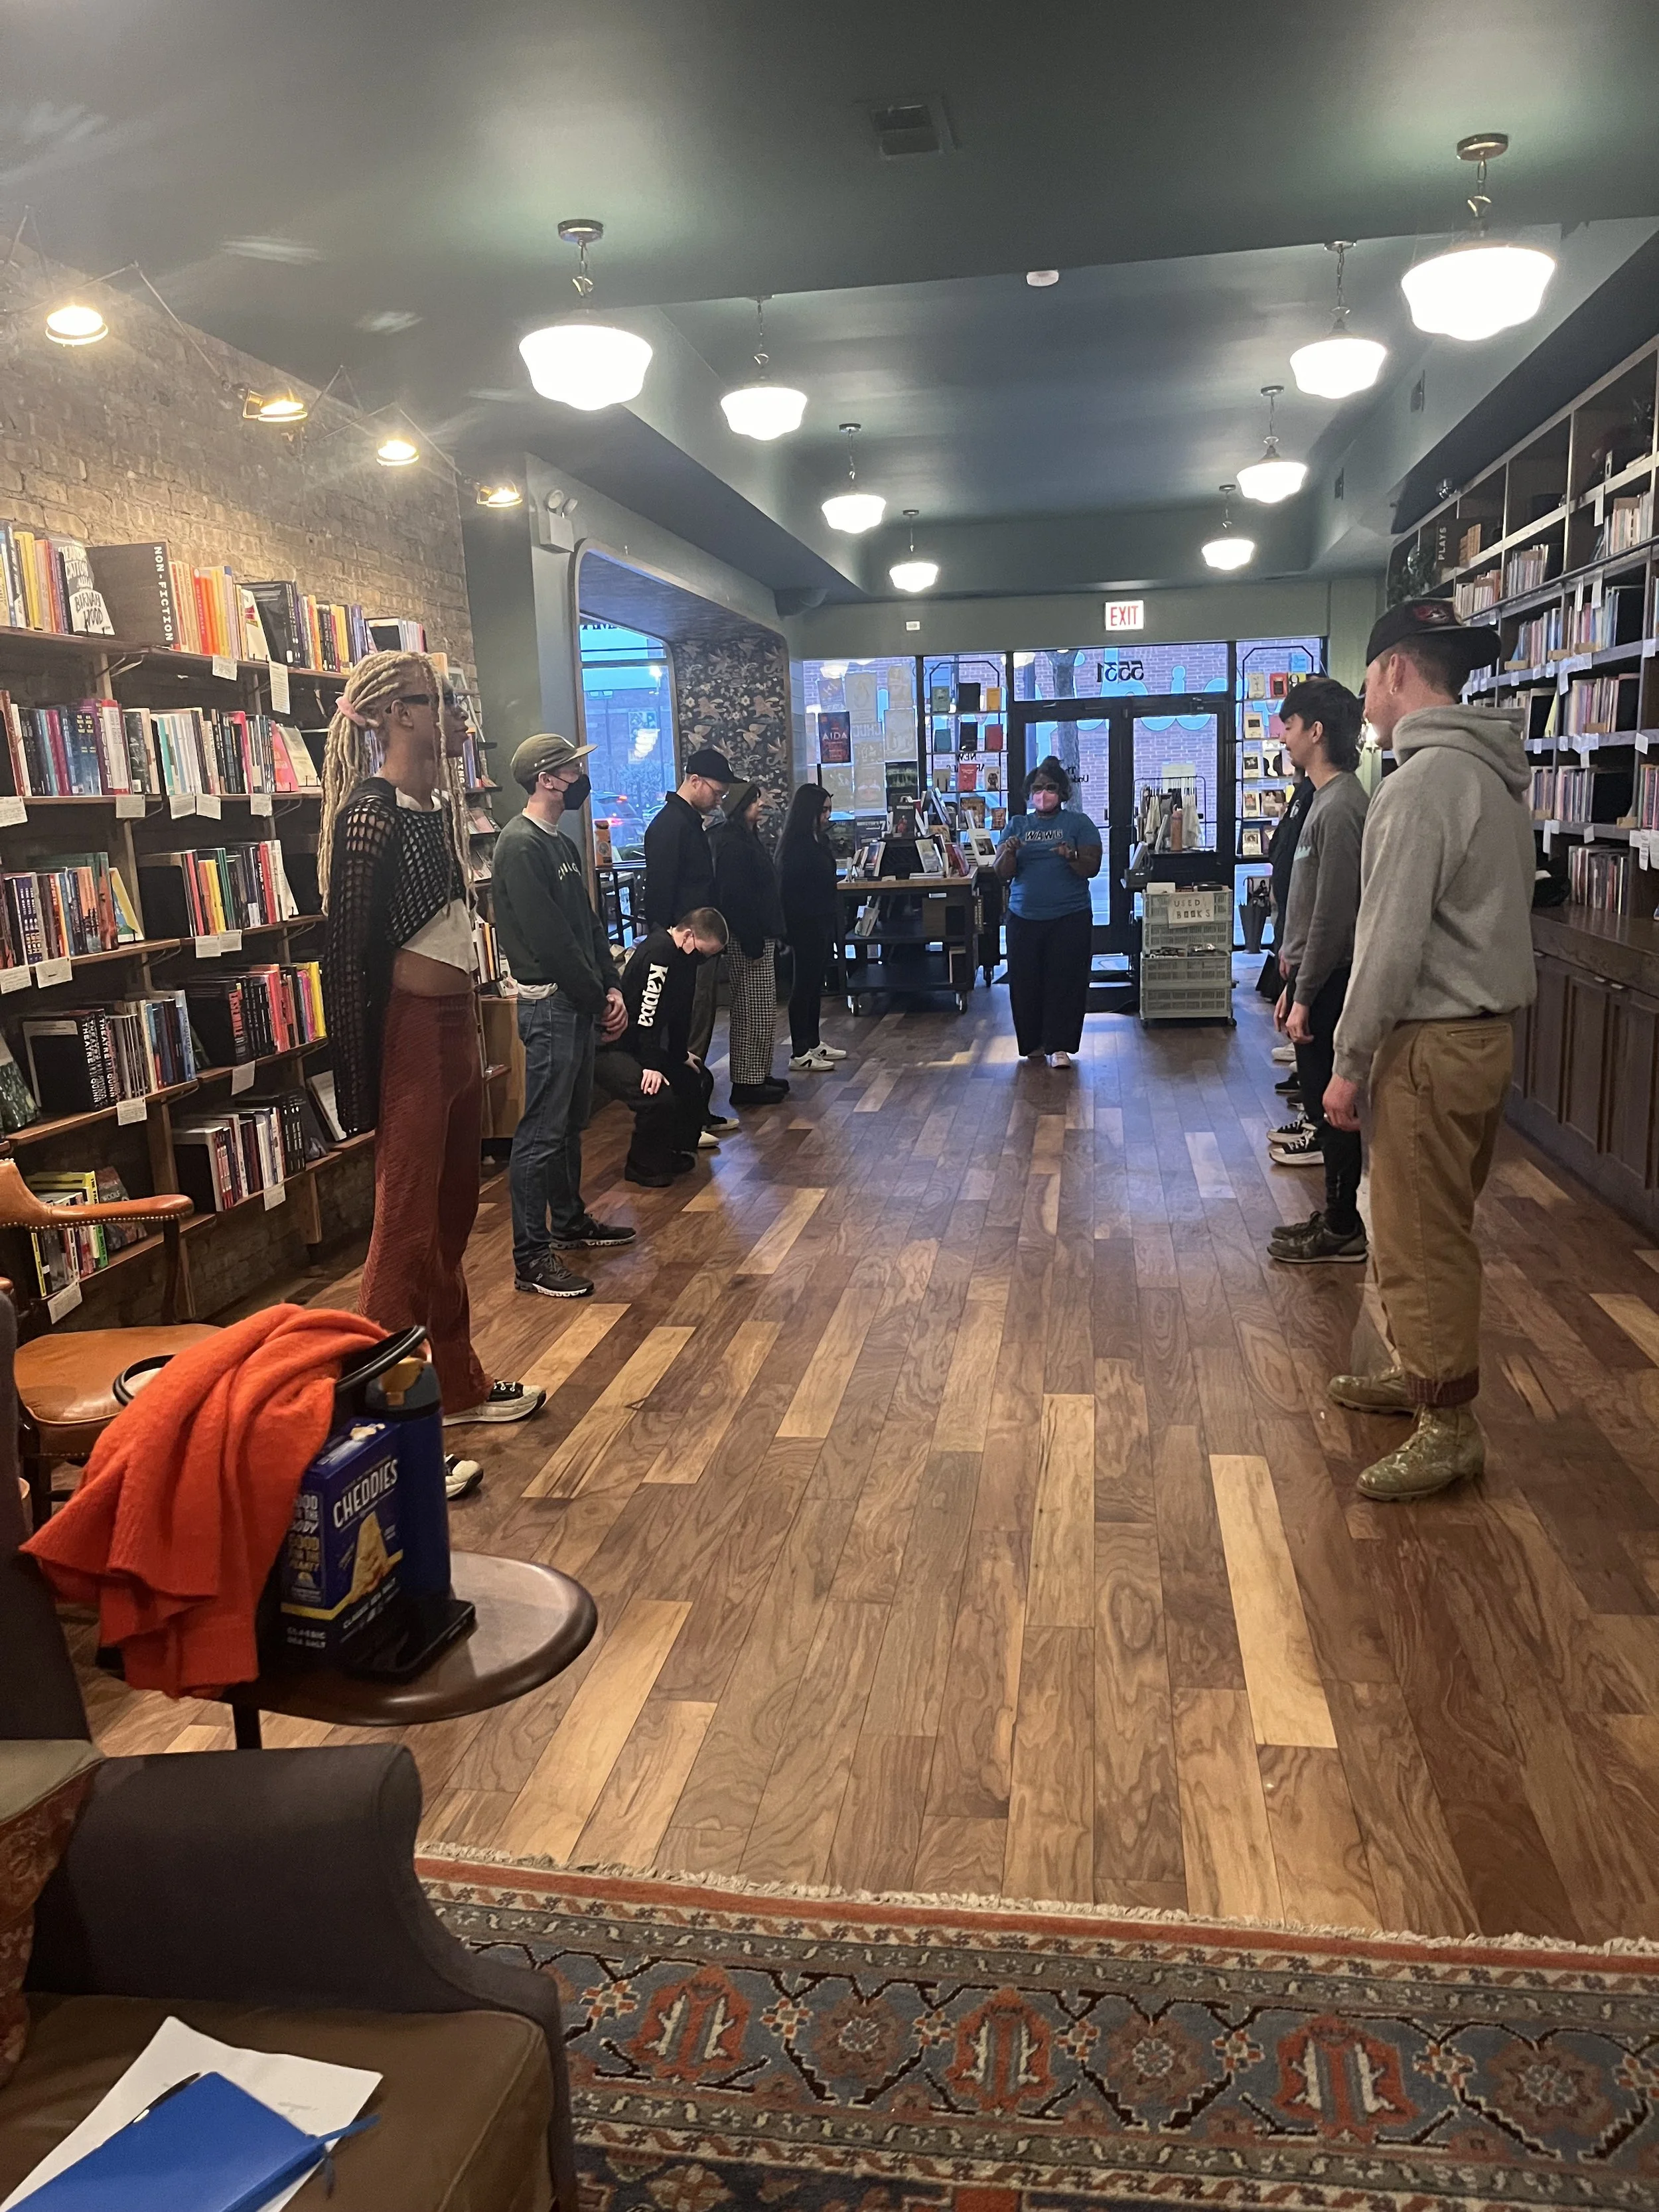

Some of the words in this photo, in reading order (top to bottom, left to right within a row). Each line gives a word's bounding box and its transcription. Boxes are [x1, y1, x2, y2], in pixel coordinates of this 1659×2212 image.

[1437, 526, 1447, 561] PLAYS
[153, 546, 175, 642] NON-FICTION
[84, 607, 104, 628] WOOD
[1110, 605, 1139, 627] EXIT
[822, 731, 848, 741] AIDA
[1173, 899, 1200, 908] USED
[1176, 909, 1211, 920] BOOKS
[637, 962, 669, 1027] Kappa
[82, 1022, 95, 1065] THEATRE
[90, 1078, 101, 1103] QUINN
[98, 1018, 109, 1060] THEATRE
[106, 1073, 116, 1099] QUINN
[295, 1494, 319, 1510] OOD
[333, 1459, 399, 1528] CHEDDIES
